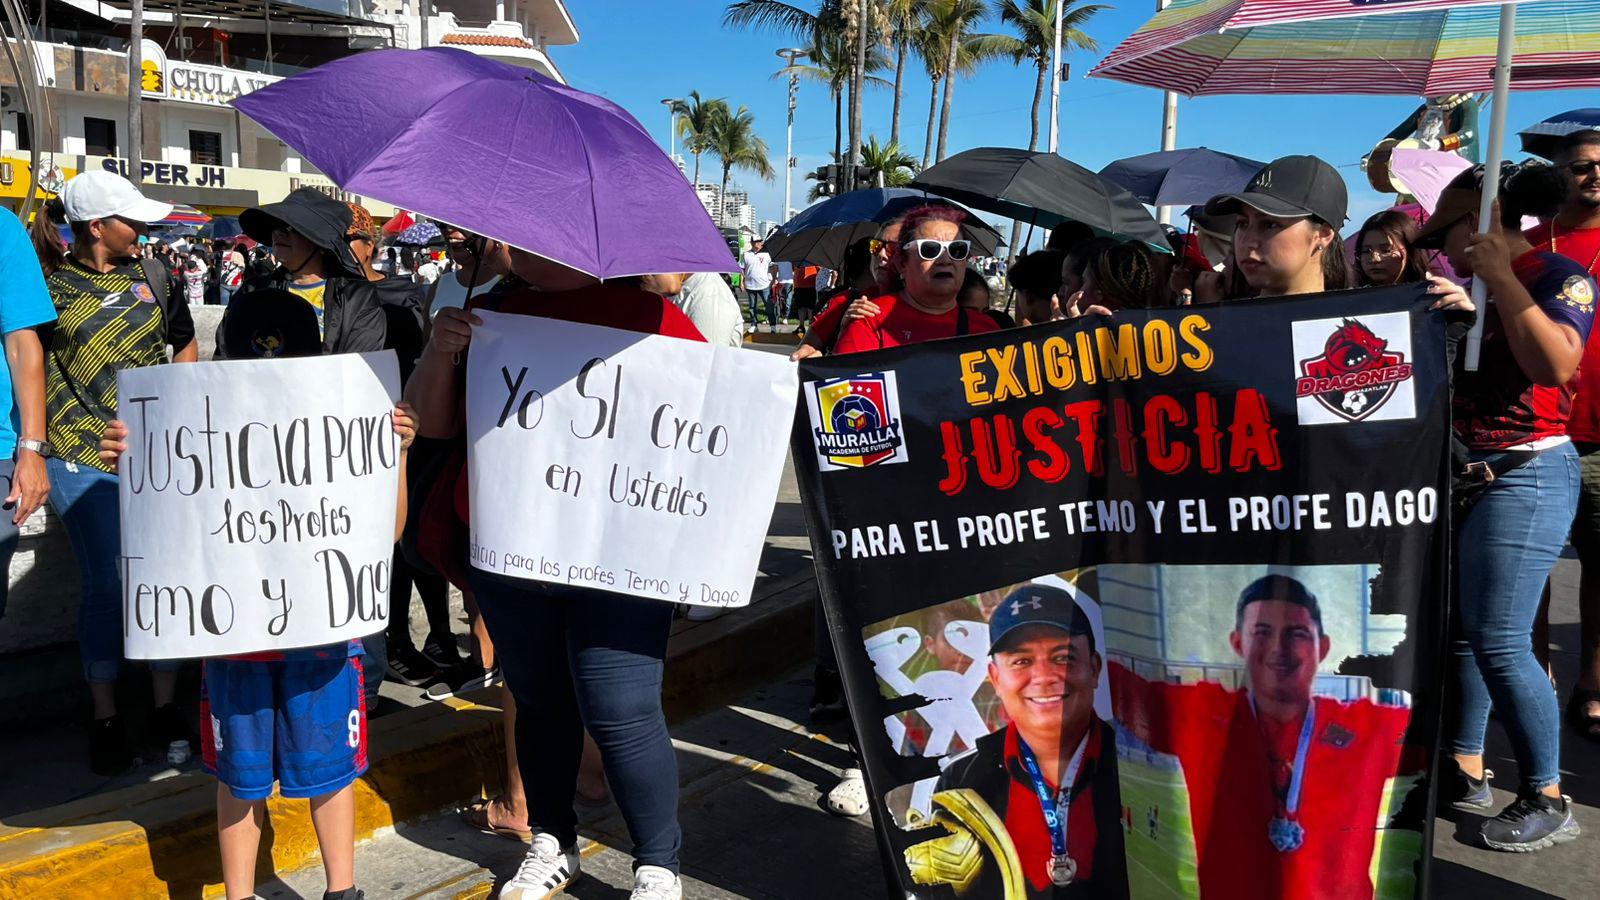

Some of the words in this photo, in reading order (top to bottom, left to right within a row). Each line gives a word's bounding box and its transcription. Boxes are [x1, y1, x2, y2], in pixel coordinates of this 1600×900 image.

[171, 68, 242, 96] CHULA
[195, 166, 225, 188] JH
[960, 314, 1214, 406] EXIGIMOS
[1296, 363, 1413, 398] DRAGONES
[497, 365, 544, 430] Yo
[570, 357, 622, 440] SI
[651, 403, 729, 457] Creo
[129, 395, 312, 496] Justicia
[323, 409, 396, 484] para
[820, 426, 896, 448] MURALLA
[938, 388, 1283, 496] JUSTICIA
[545, 464, 582, 498] en
[609, 463, 708, 517] Ustedes
[832, 523, 906, 560] PARA
[913, 519, 950, 553] EL
[957, 507, 1050, 549] PROFE
[1058, 500, 1136, 535] TEMO
[1147, 500, 1165, 534] Y
[1178, 499, 1217, 533] EL
[1228, 493, 1332, 532] PROFE
[1345, 486, 1438, 528] DAGO
[121, 555, 235, 638] Temo
[262, 579, 292, 636] y
[504, 552, 534, 573] para
[540, 556, 561, 577] los
[567, 564, 615, 585] profes
[625, 568, 670, 595] Temo
[679, 580, 690, 602] y
[348, 709, 360, 748] 8
